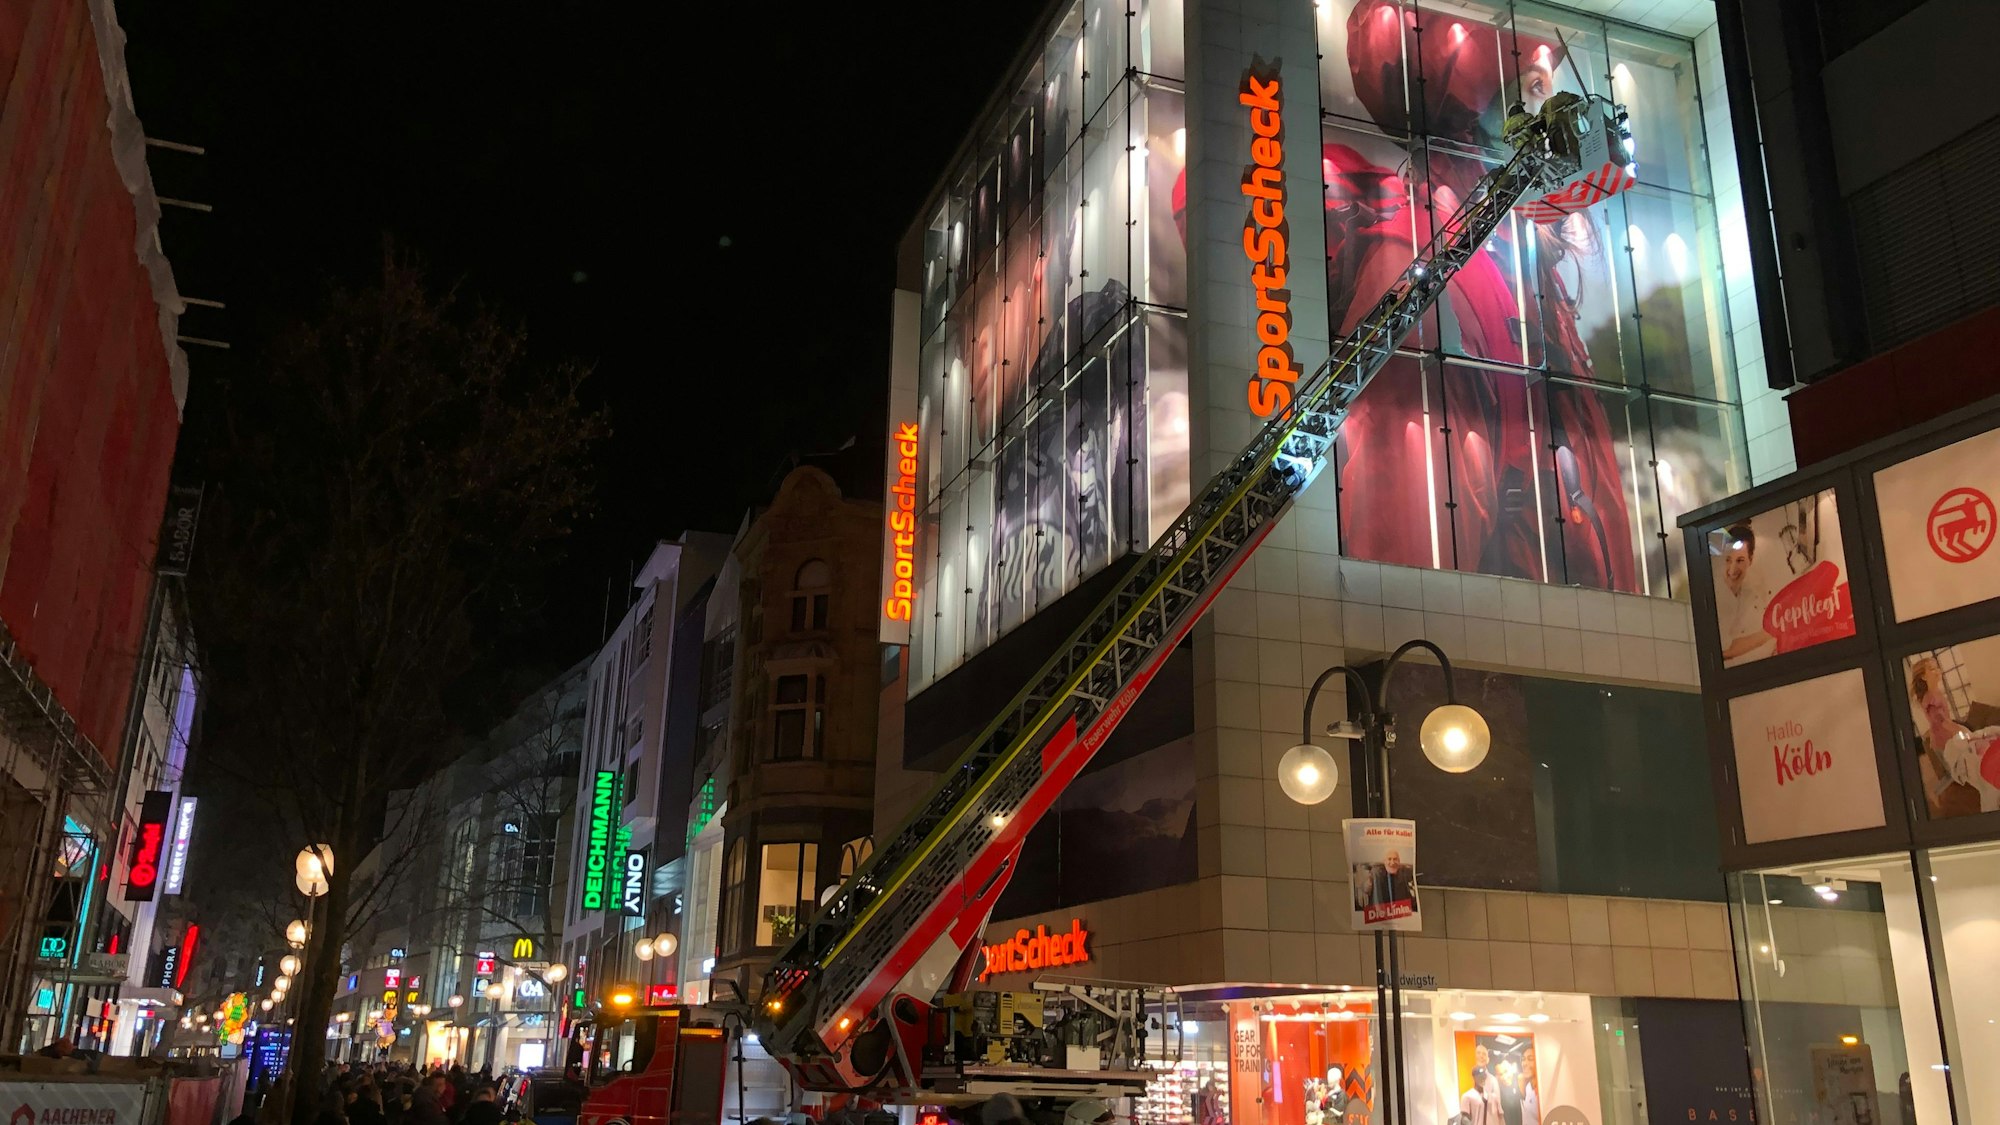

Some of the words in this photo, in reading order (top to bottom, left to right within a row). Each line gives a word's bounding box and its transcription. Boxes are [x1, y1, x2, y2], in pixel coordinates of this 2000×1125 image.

[1239, 76, 1300, 420] SportScheck
[885, 421, 920, 622] SportScheck
[1771, 586, 1841, 633] Gepflegt
[1083, 705, 1122, 751] Feuerwehr
[1119, 686, 1138, 709] Köln
[1766, 720, 1804, 743] Hallo
[1773, 739, 1832, 786] Köln
[584, 771, 614, 909] DEICHMANN
[1383, 828, 1394, 836] für
[625, 854, 644, 912] ONLY
[1368, 909, 1386, 921] Die
[161, 946, 178, 989] EPHORA
[978, 918, 1090, 983] portScheck
[1386, 973, 1438, 988] Ldwigstr.
[1234, 1029, 1256, 1043] GEAR
[1234, 1045, 1245, 1058] UP
[1245, 1044, 1261, 1058] FOR
[40, 1108, 116, 1125] AACHENER
